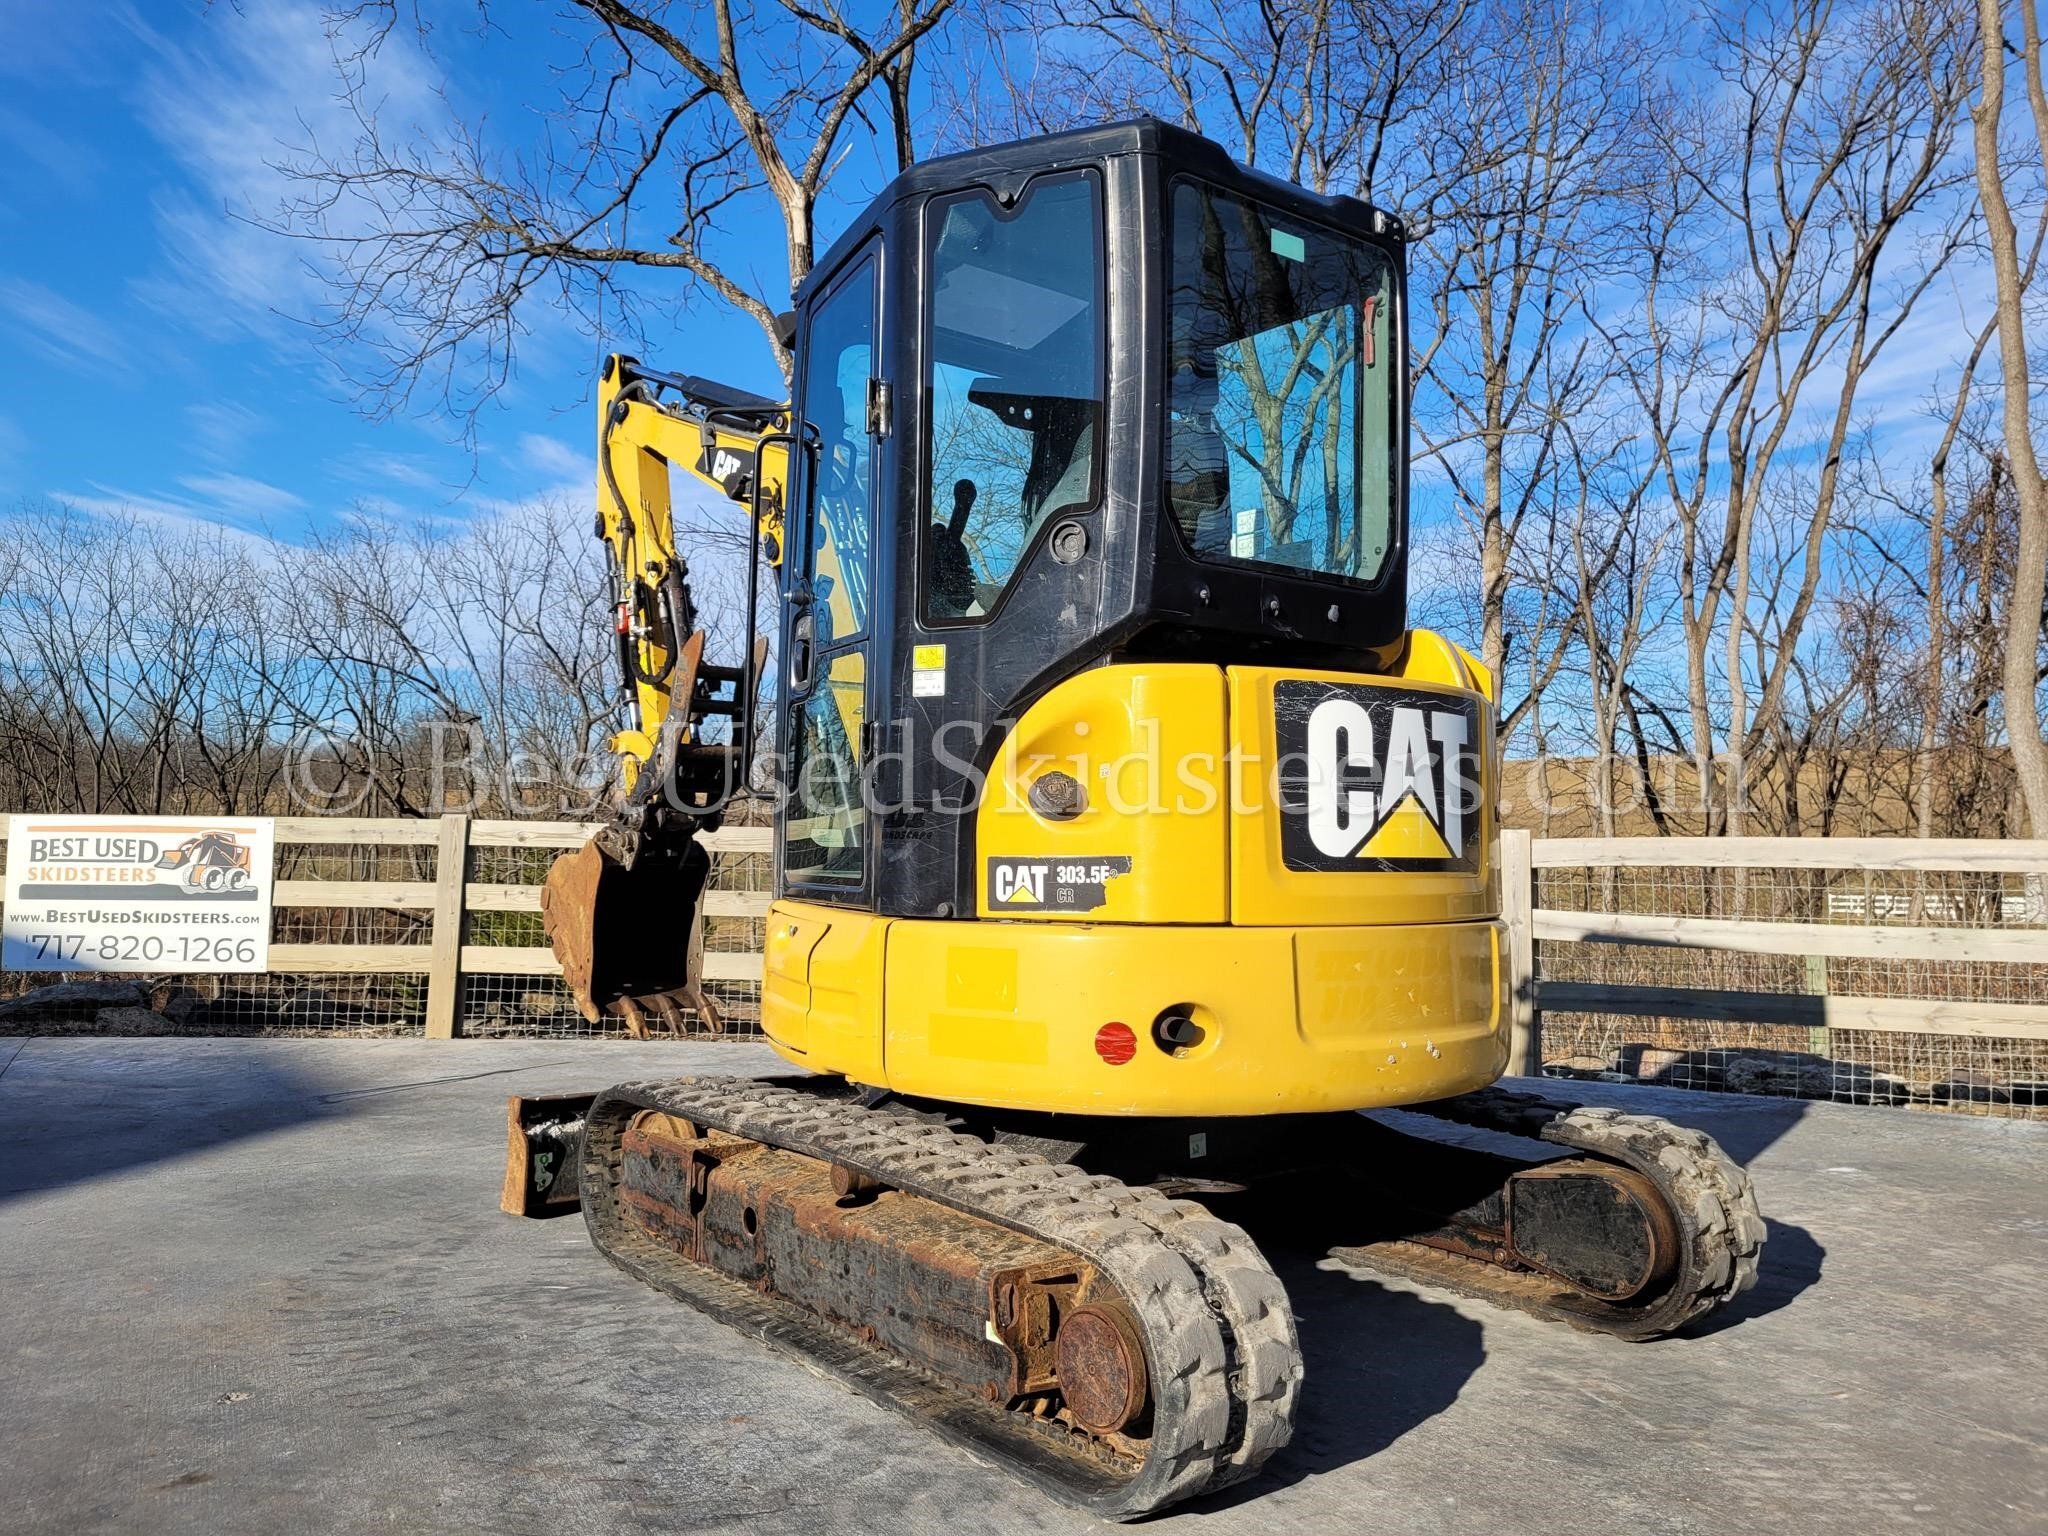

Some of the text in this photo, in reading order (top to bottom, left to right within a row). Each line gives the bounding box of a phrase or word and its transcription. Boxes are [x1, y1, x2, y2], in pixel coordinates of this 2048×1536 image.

[713, 450, 741, 482] CAT
[1308, 700, 1467, 858] CAT
[30, 838, 159, 863] BEST USED
[28, 866, 156, 882] SKIDSTEERS
[996, 865, 1048, 902] CAT
[1057, 888, 1074, 903] CR
[32, 934, 255, 963] 717-820-1266
